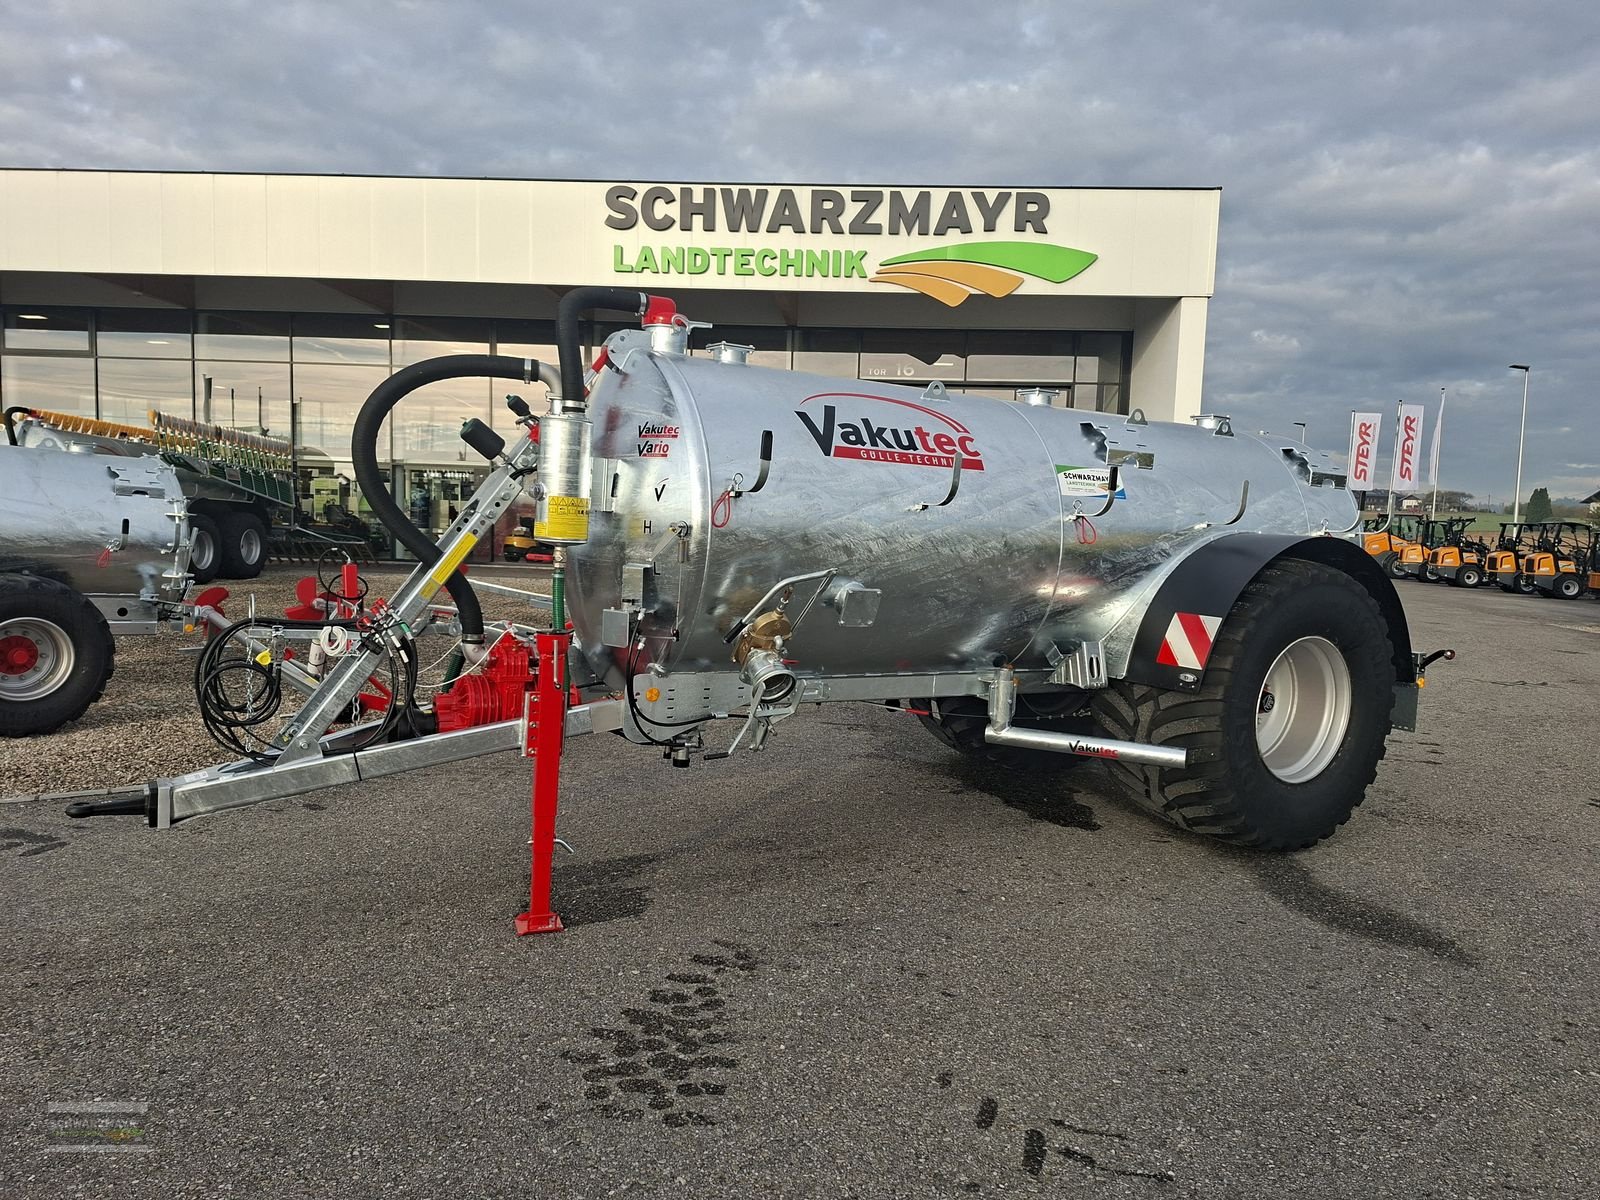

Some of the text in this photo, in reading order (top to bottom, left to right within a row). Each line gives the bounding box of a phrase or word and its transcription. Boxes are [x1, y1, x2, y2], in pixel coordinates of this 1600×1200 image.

[604, 185, 1051, 236] SCHWARZMAYR
[613, 244, 868, 279] LANDTECHNIK
[638, 421, 680, 438] Vakutec
[794, 405, 981, 457] Vakutec
[637, 440, 670, 456] Vario
[1354, 422, 1372, 482] STEYR
[1399, 415, 1416, 482] STEYR
[860, 450, 953, 467] GÜLLE-TECHNI
[1063, 472, 1109, 482] SCHWARZMAY
[643, 519, 652, 534] H
[1069, 740, 1119, 756] Vakutec
